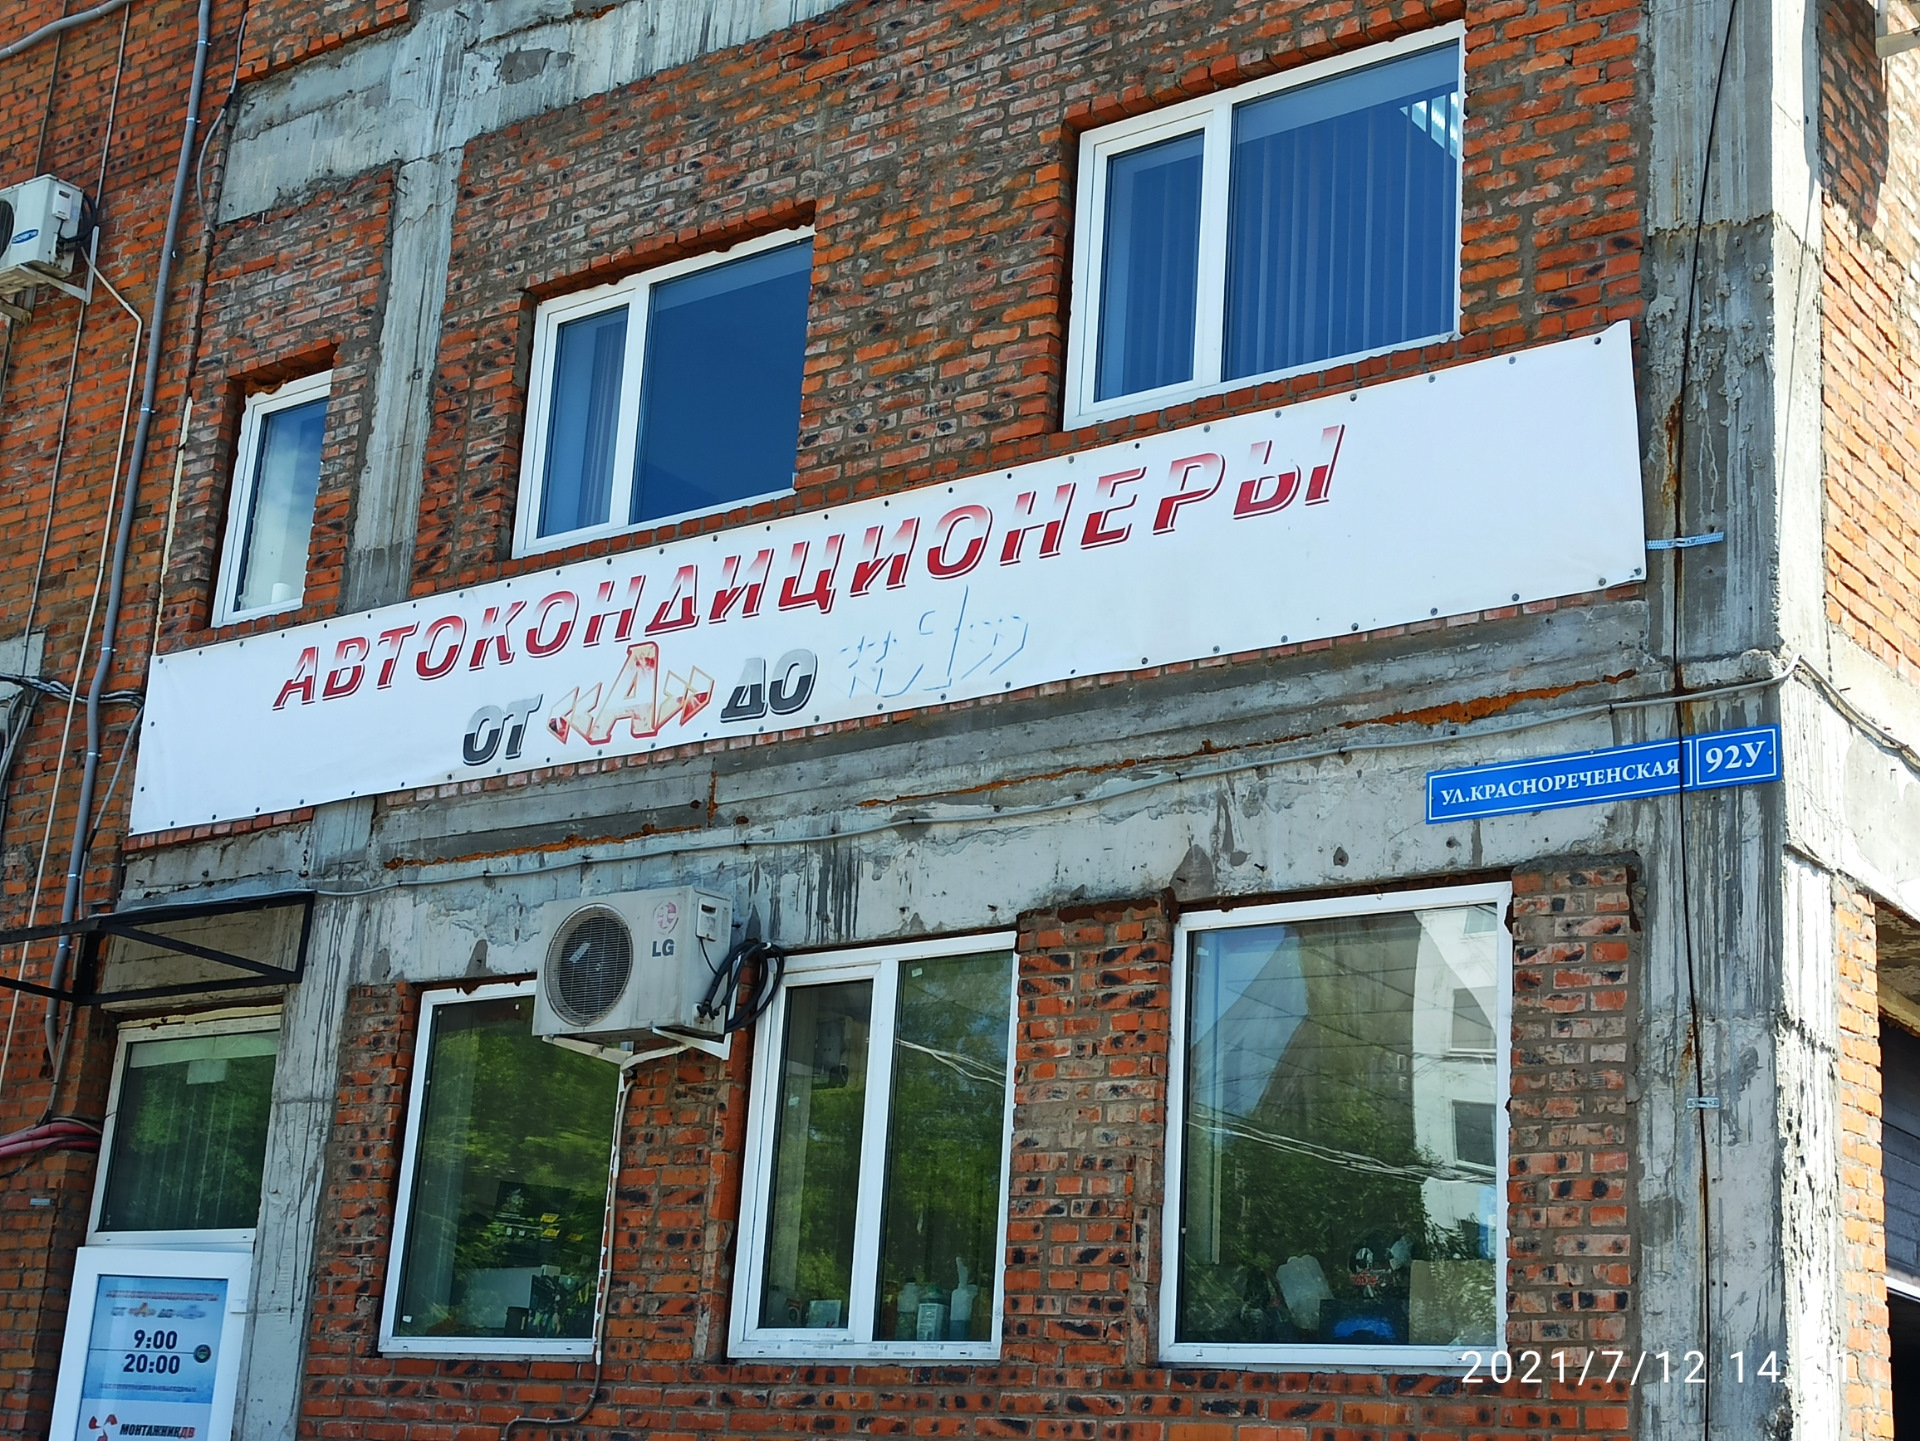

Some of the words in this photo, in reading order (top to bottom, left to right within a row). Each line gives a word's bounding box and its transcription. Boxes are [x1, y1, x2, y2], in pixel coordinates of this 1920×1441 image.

[272, 424, 1346, 711] АВТОКОНДИЦИОНЕРЫ
[462, 693, 544, 766] ОТ
[720, 648, 818, 723] ДО
[1705, 740, 1767, 774] 92У
[652, 938, 675, 957] LG
[134, 1329, 178, 1350] 9:00
[122, 1353, 180, 1375] 20:00
[119, 1423, 197, 1440] МОНТАЖНИКДВ
